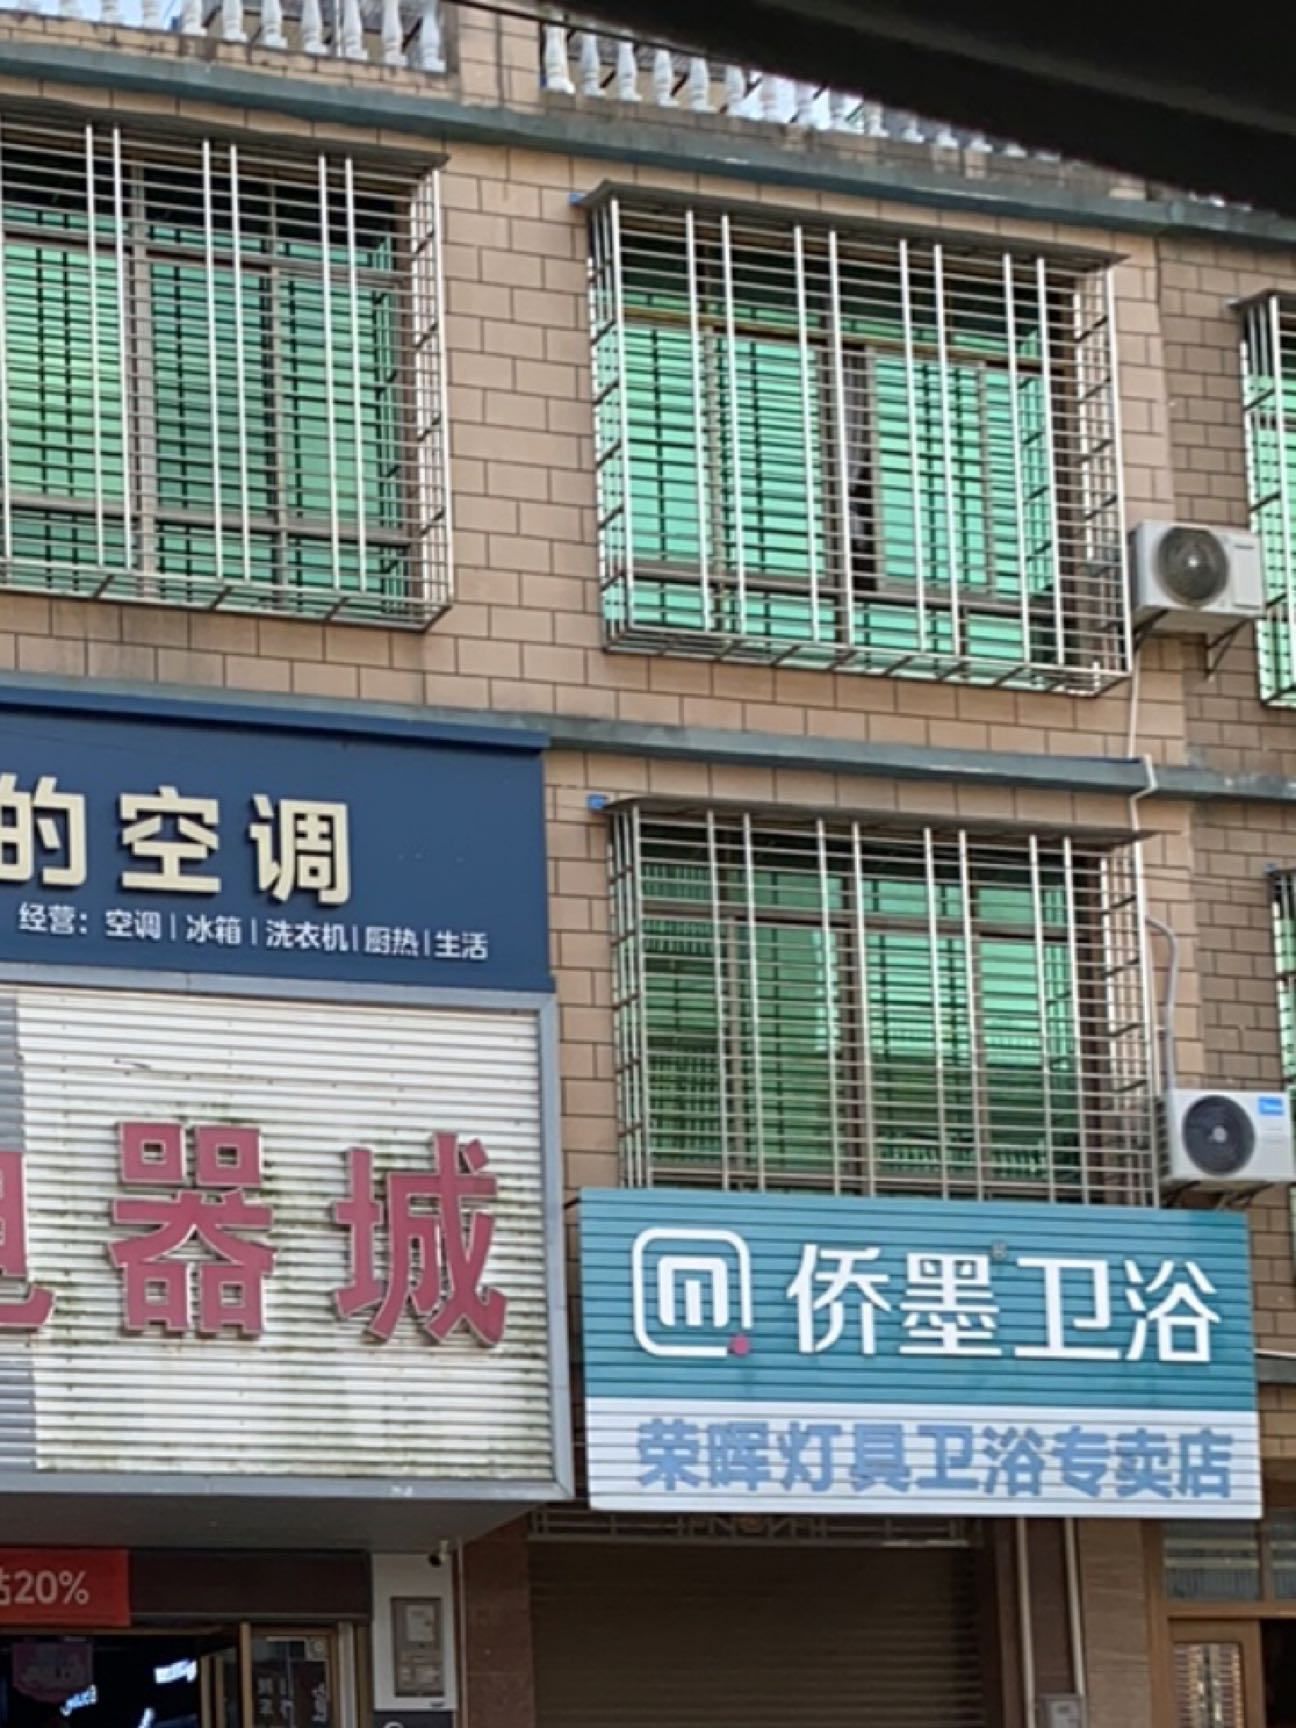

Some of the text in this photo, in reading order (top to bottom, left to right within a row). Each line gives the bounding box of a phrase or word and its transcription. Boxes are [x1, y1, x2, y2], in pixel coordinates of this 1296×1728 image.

[786, 1243, 1222, 1364] 侨墨卫浴
[637, 1417, 1233, 1499] 荣晖灯具卫浴专卖店
